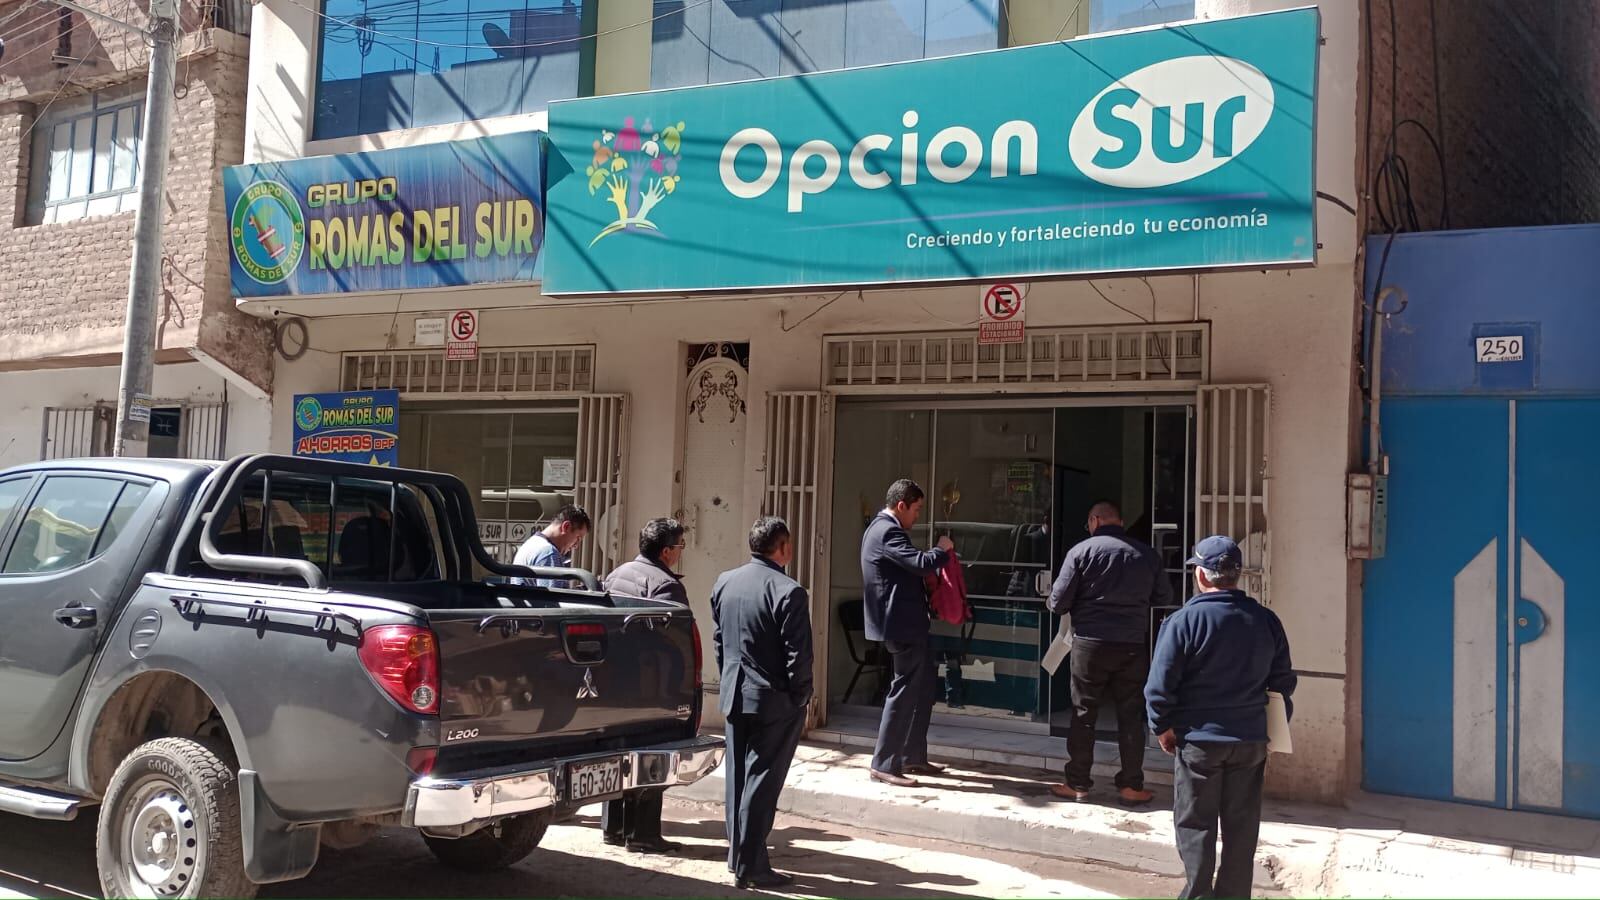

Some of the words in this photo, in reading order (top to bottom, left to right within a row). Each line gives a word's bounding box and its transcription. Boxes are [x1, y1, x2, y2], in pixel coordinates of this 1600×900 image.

[719, 110, 1038, 212] Opcion
[1091, 88, 1246, 169] Sur
[247, 184, 282, 201] GRUPO
[307, 177, 397, 208] GRUPO
[309, 211, 405, 270] ROMAS
[412, 206, 467, 263] DEL
[475, 199, 535, 258] SUR
[906, 231, 993, 249] Creciendo
[997, 232, 1006, 247] y
[1010, 219, 1135, 243] fortaleciendo
[1144, 218, 1163, 234] tu
[1167, 208, 1269, 232] economía
[237, 245, 266, 279] ROMAS
[268, 267, 289, 280] DEL
[286, 241, 302, 266] SUR
[1482, 339, 1520, 357] 250
[322, 409, 355, 427] ROMAS
[356, 408, 373, 425] DEL
[375, 406, 394, 424] SUR
[296, 434, 372, 454] AHORROS
[485, 524, 502, 539] SUR
[447, 728, 480, 741] L200
